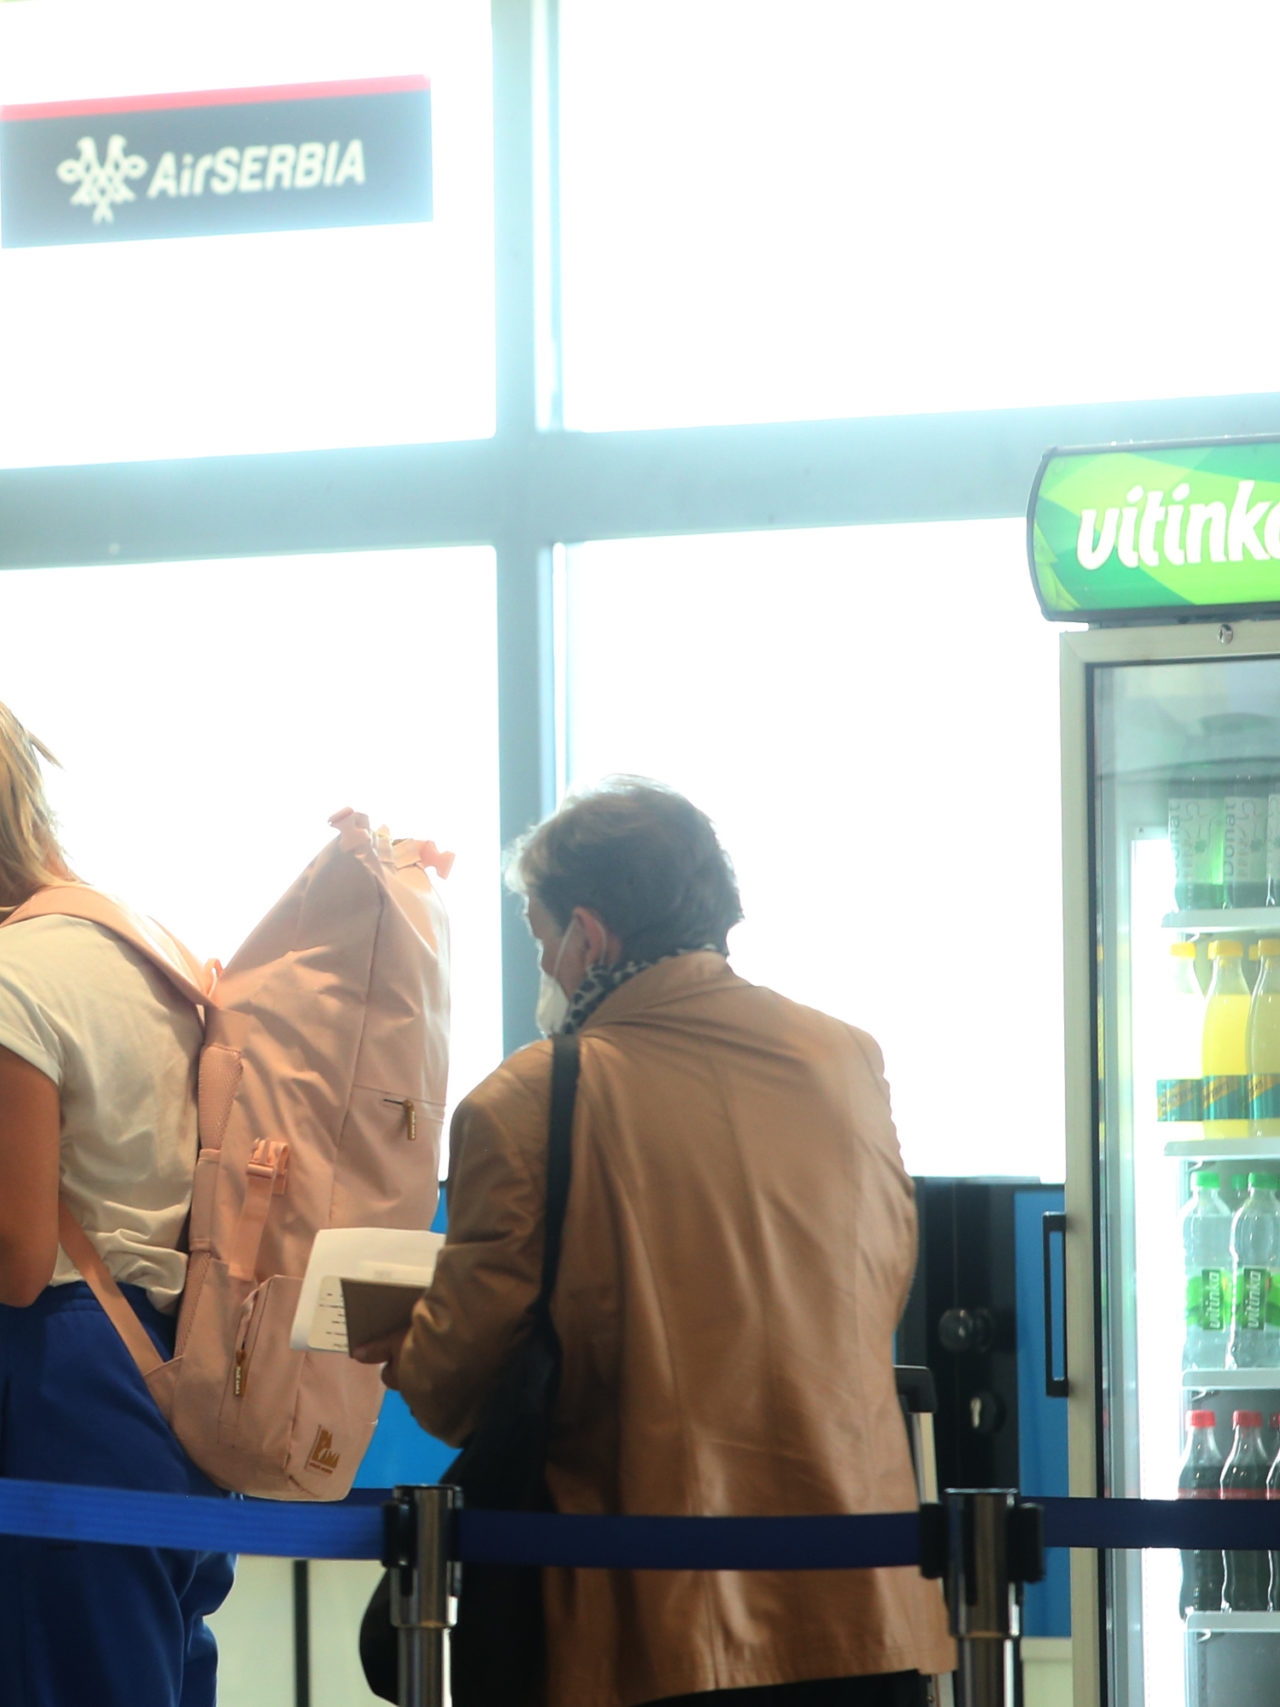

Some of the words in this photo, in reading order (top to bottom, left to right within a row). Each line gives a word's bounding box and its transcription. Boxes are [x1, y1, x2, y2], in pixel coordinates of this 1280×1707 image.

[147, 139, 367, 200] AirSERBIA
[1205, 1271, 1221, 1329] vitinka
[1246, 1271, 1262, 1328] vitinka
